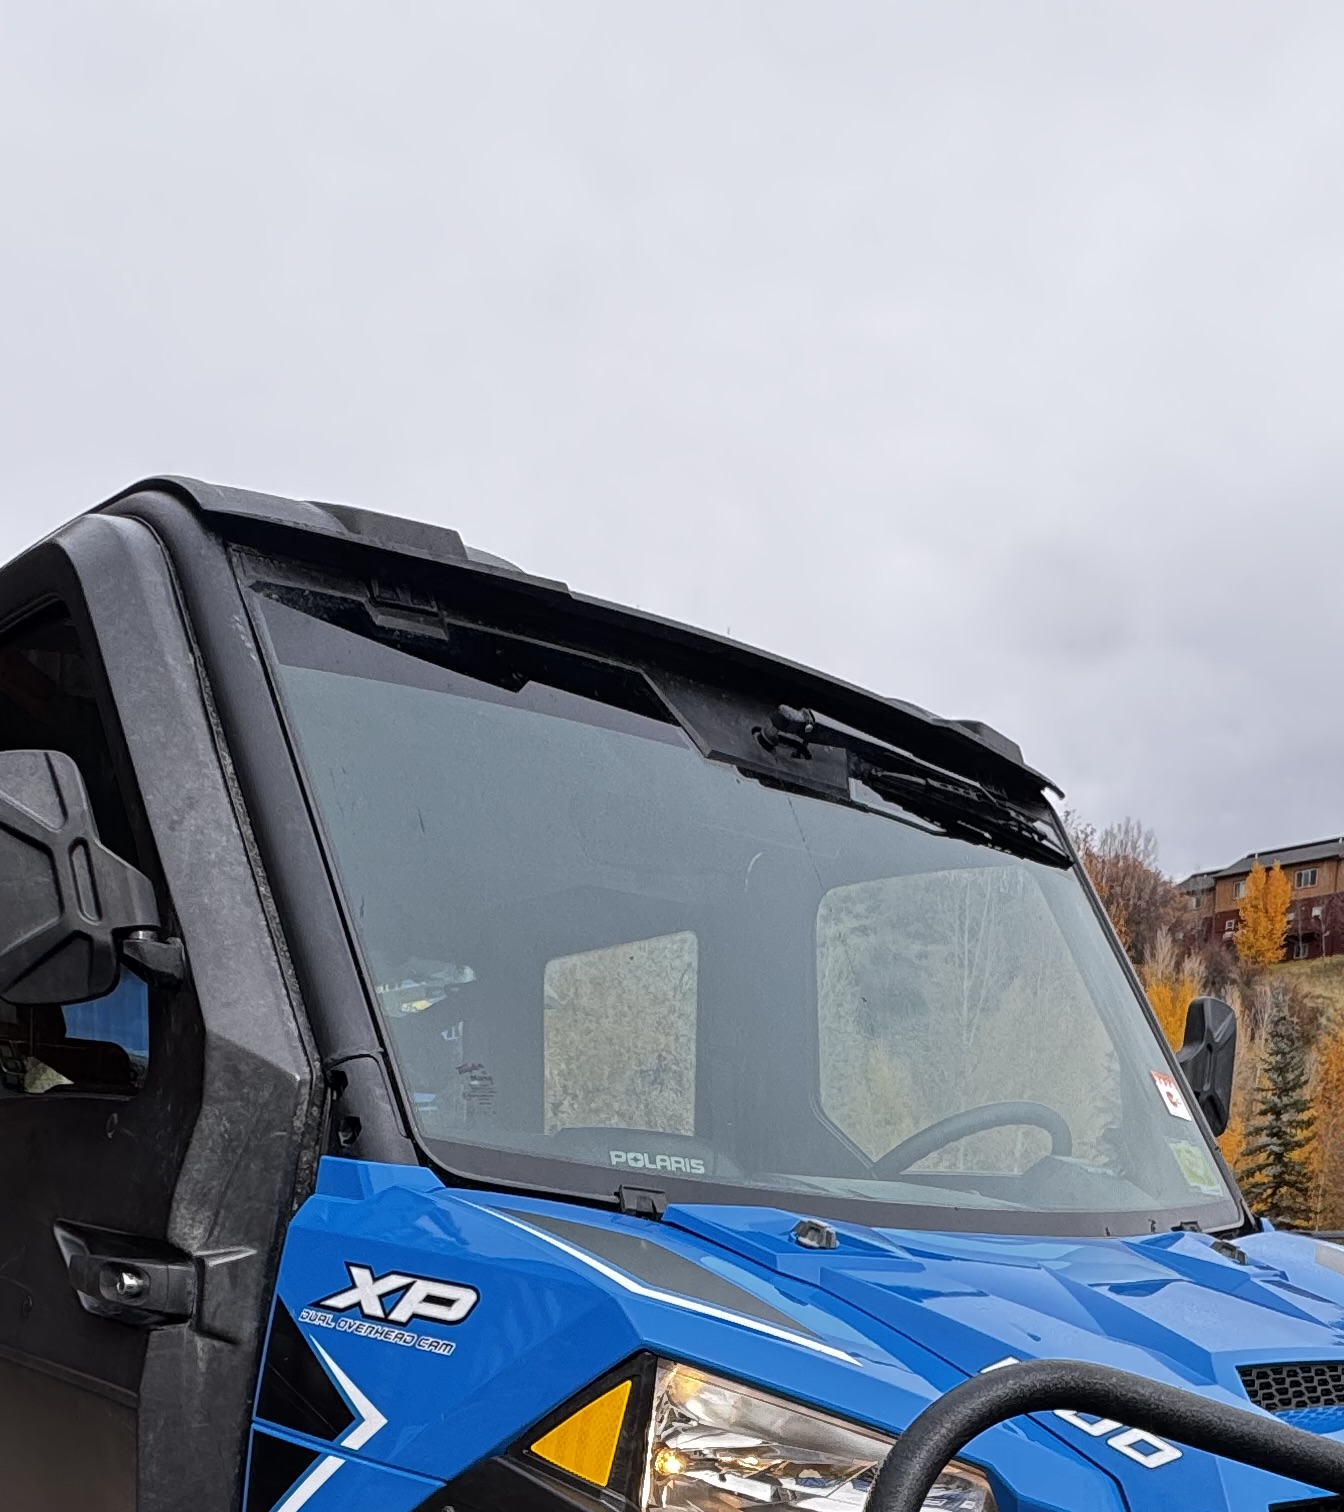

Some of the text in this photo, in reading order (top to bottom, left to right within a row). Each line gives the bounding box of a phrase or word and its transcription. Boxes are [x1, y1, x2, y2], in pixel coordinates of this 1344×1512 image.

[609, 1150, 705, 1174] POLARIS
[311, 1262, 479, 1325] XP
[299, 1309, 455, 1356] DUAL OVERHEAD CAM
